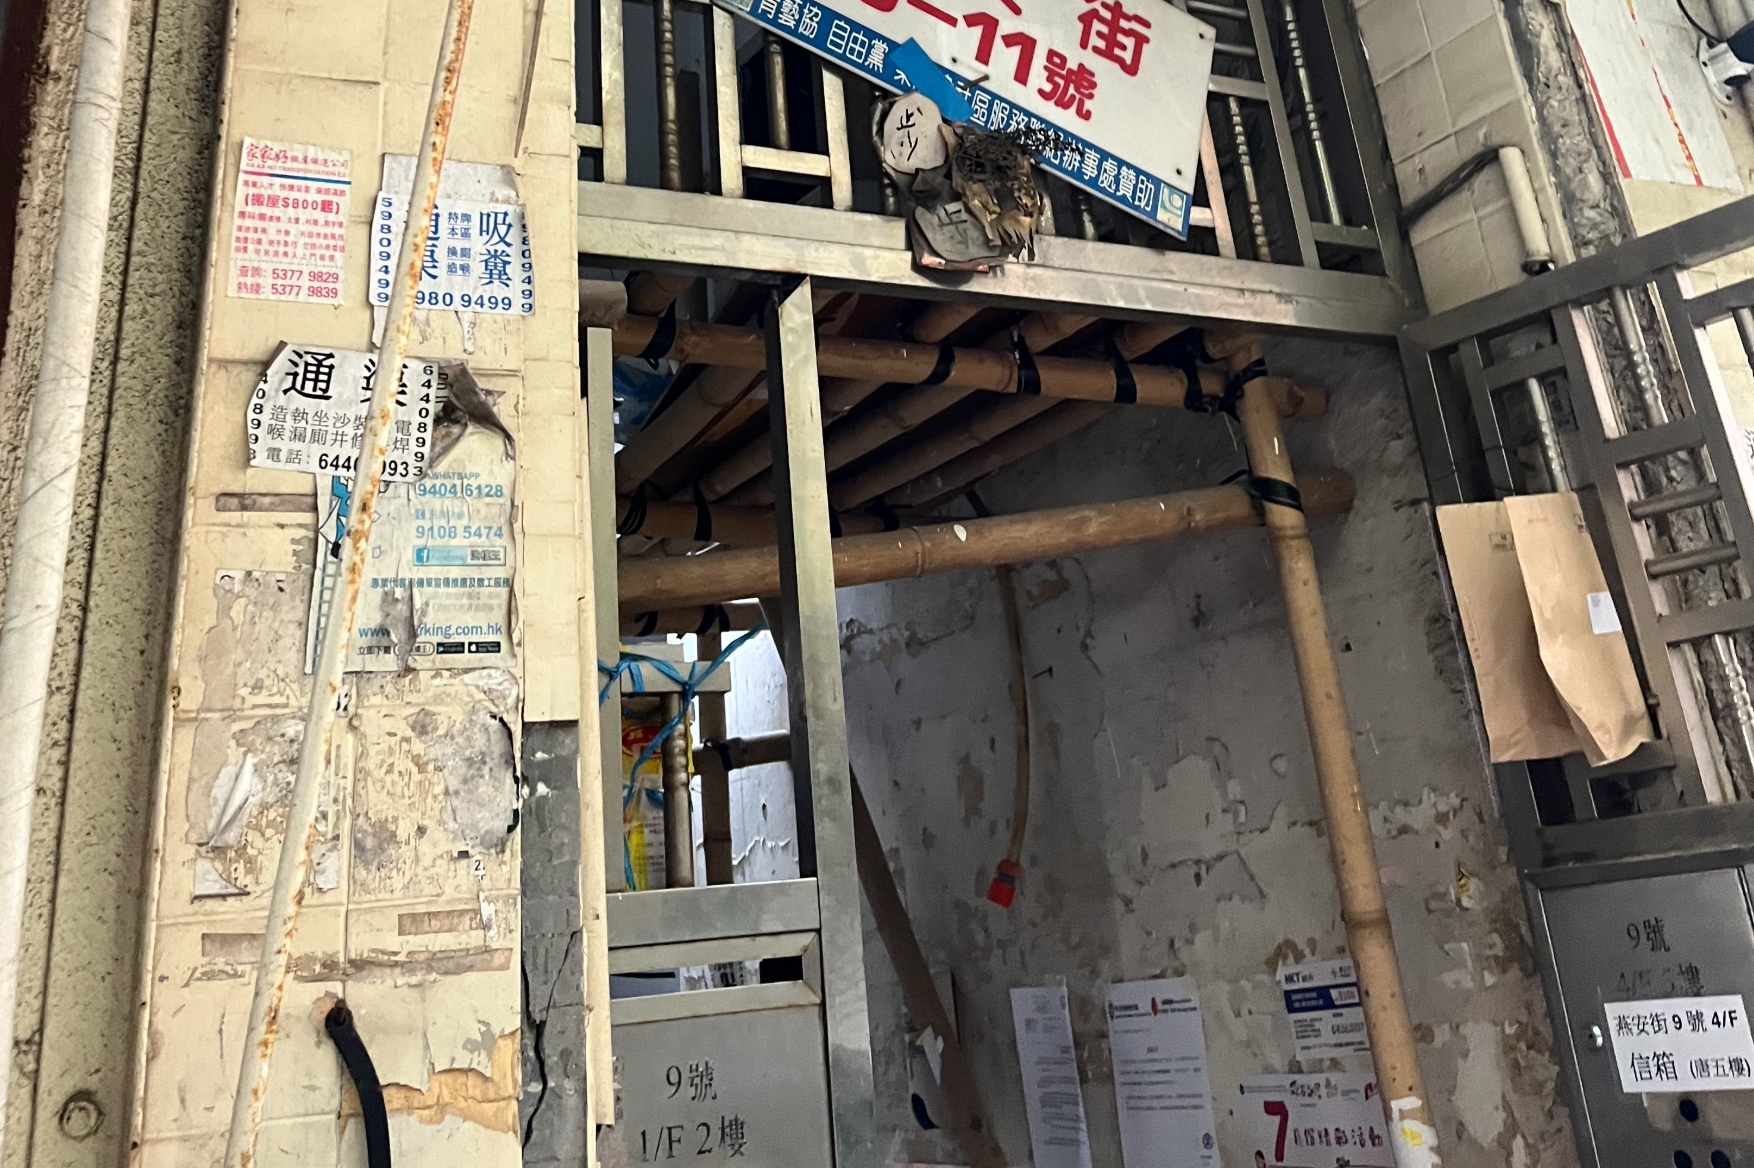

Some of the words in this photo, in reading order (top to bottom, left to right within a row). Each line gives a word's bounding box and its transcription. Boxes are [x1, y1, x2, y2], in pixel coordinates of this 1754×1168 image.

[827, 19, 889, 74] 自由黨
[377, 197, 393, 303] 59809499
[478, 210, 514, 288] 吸糞
[271, 283, 302, 296] 5377
[307, 286, 338, 299] 9839
[272, 268, 303, 281] 5377
[308, 271, 339, 284] 9829
[415, 290, 453, 307] 980
[460, 293, 512, 311] 9499
[413, 365, 434, 477] 64408993
[417, 482, 458, 498] 9404
[464, 483, 504, 498] 6128
[415, 525, 458, 539] 9108
[462, 525, 504, 539] 5474
[1613, 1012, 1668, 1037] 燕安街
[1711, 1010, 1739, 1028] 4/F
[665, 1059, 718, 1103] 9號
[1630, 1050, 1678, 1082] 信箱
[696, 1113, 748, 1159] 2樓
